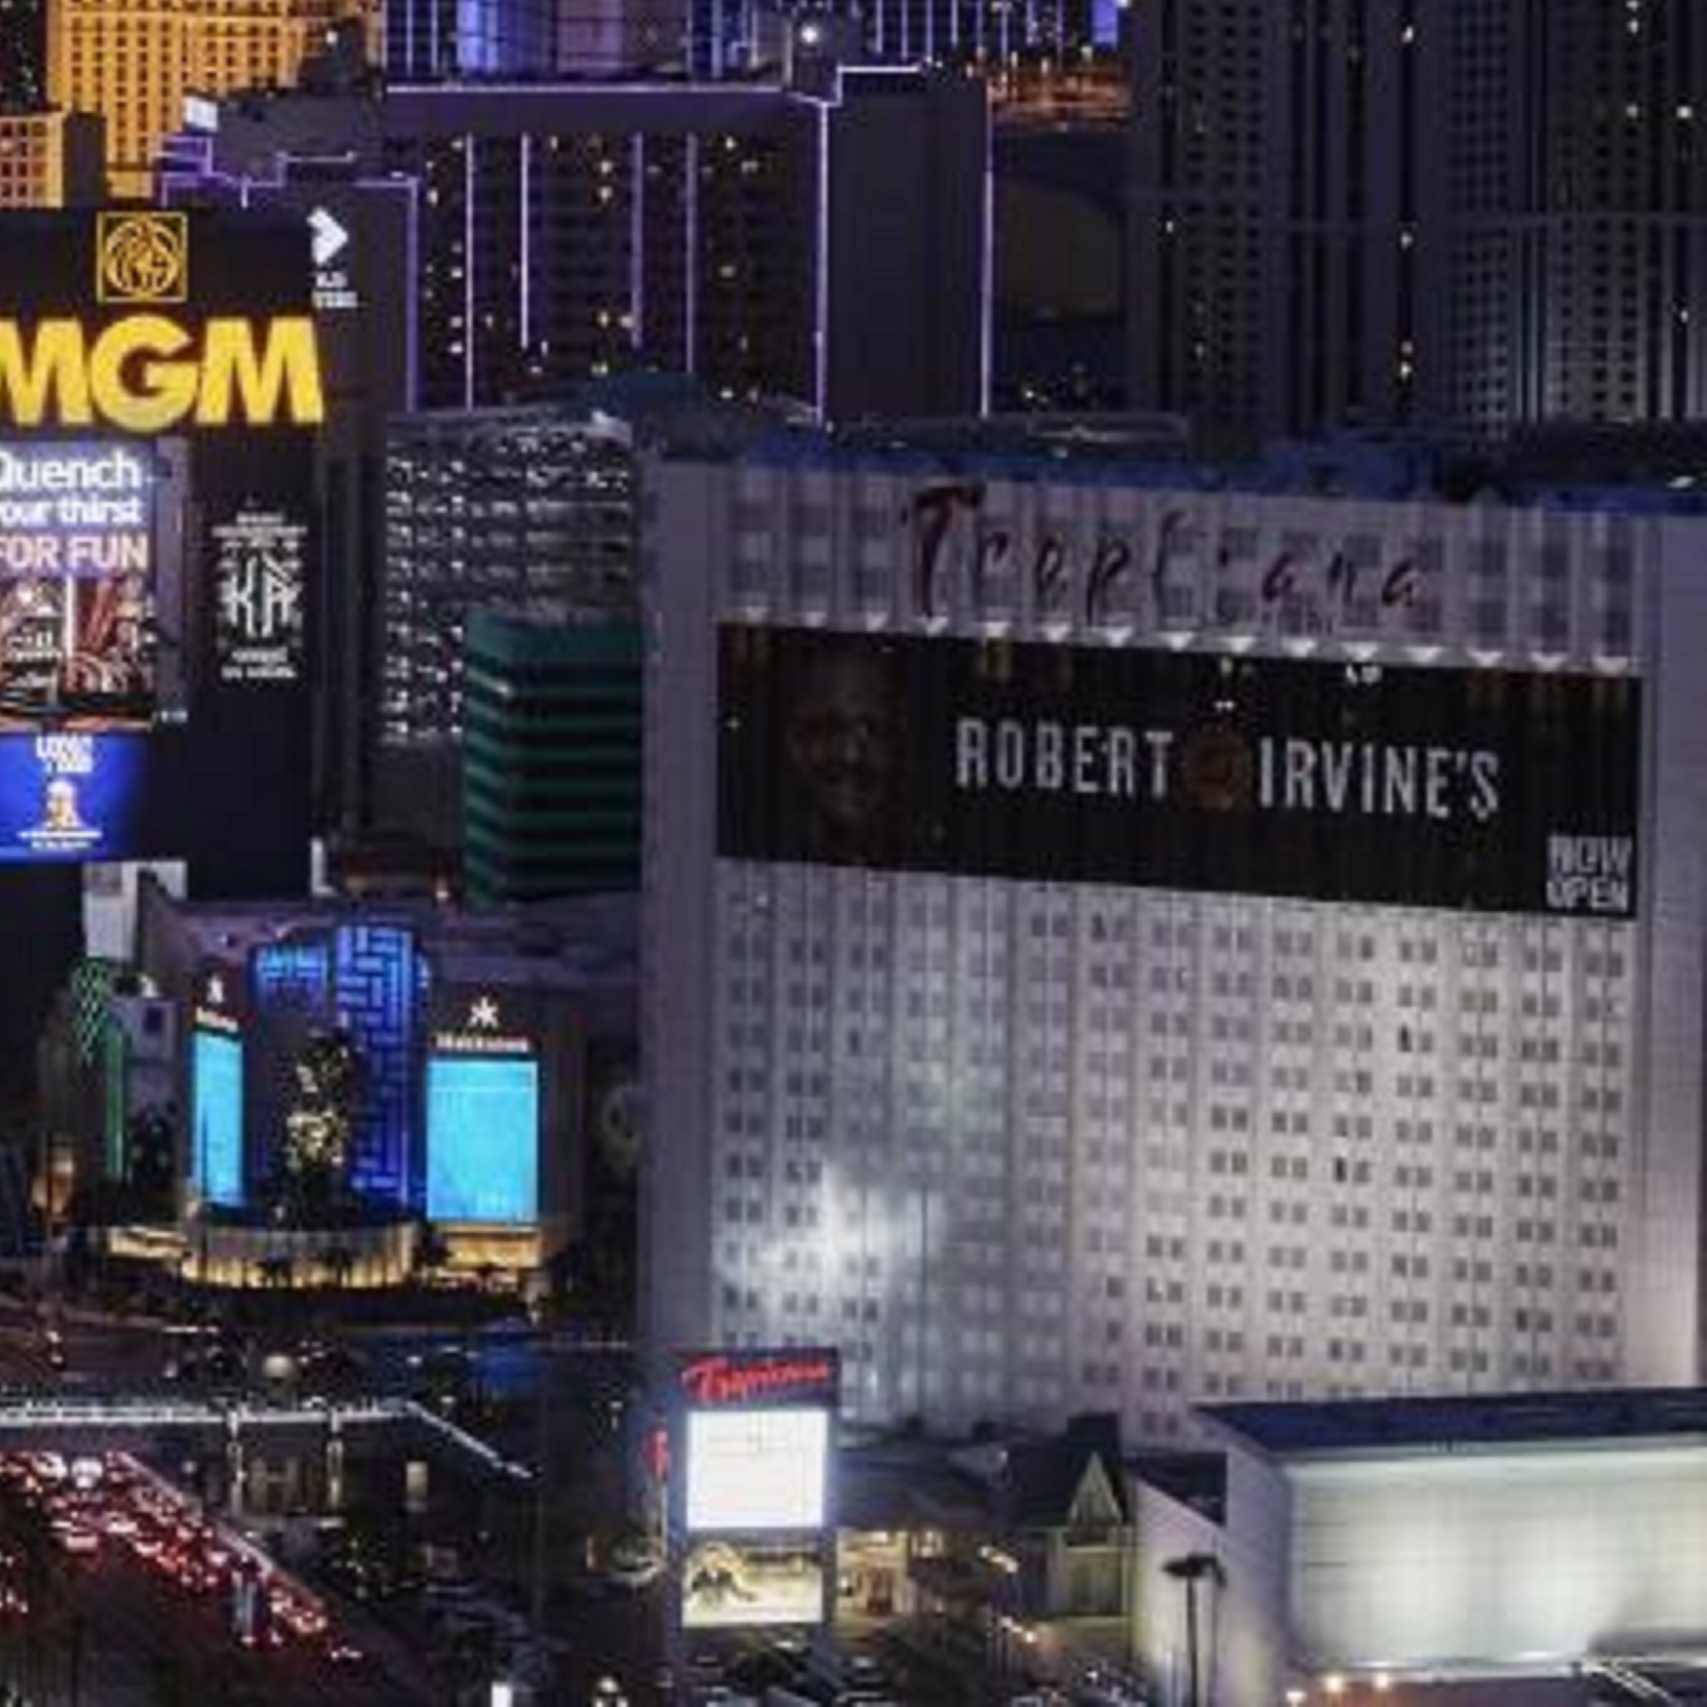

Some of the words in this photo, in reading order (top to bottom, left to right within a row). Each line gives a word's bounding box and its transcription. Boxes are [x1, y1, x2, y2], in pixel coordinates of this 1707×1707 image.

[57, 492, 144, 525] thirst
[67, 533, 150, 571] FUN
[955, 718, 1174, 799] ROBERT
[1259, 735, 1500, 821] IRVINE'S
[1547, 835, 1633, 873] NOW
[1546, 875, 1628, 910] OPEN
